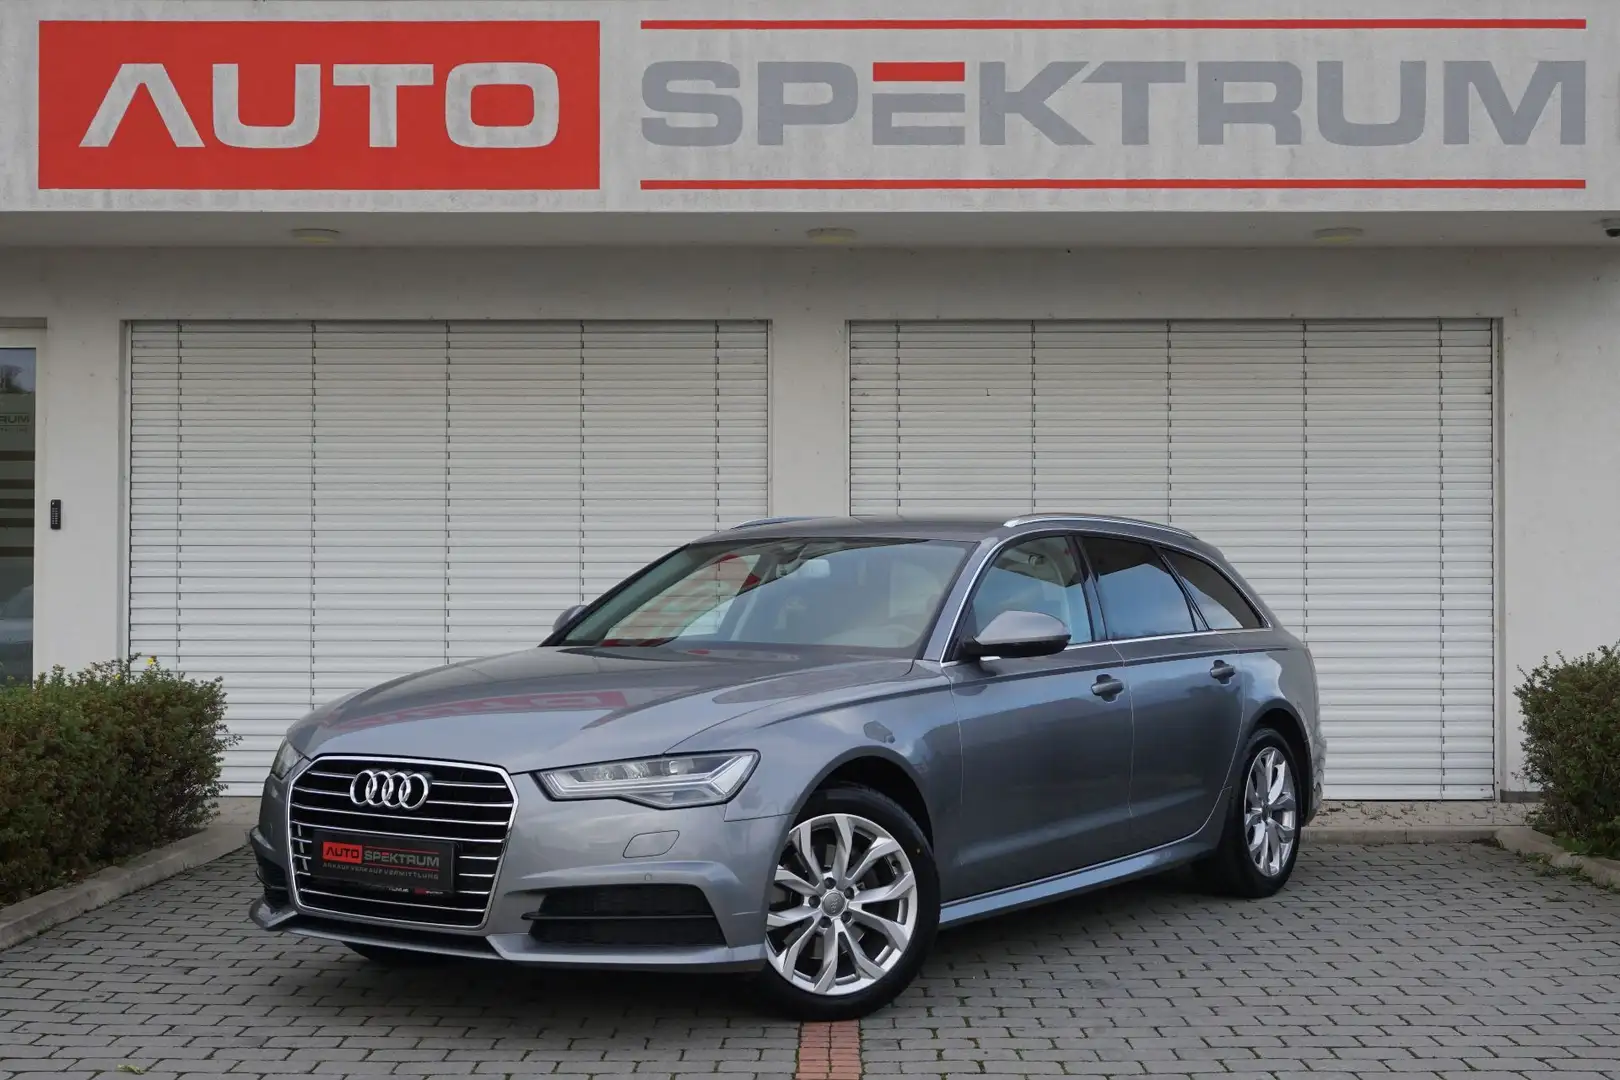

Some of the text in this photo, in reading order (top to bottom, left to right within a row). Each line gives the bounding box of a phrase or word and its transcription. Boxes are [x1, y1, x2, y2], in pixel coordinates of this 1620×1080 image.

[78, 60, 1586, 149] AUTO SPEKTRUM
[326, 846, 440, 867] AUTO SPEKTRUM
